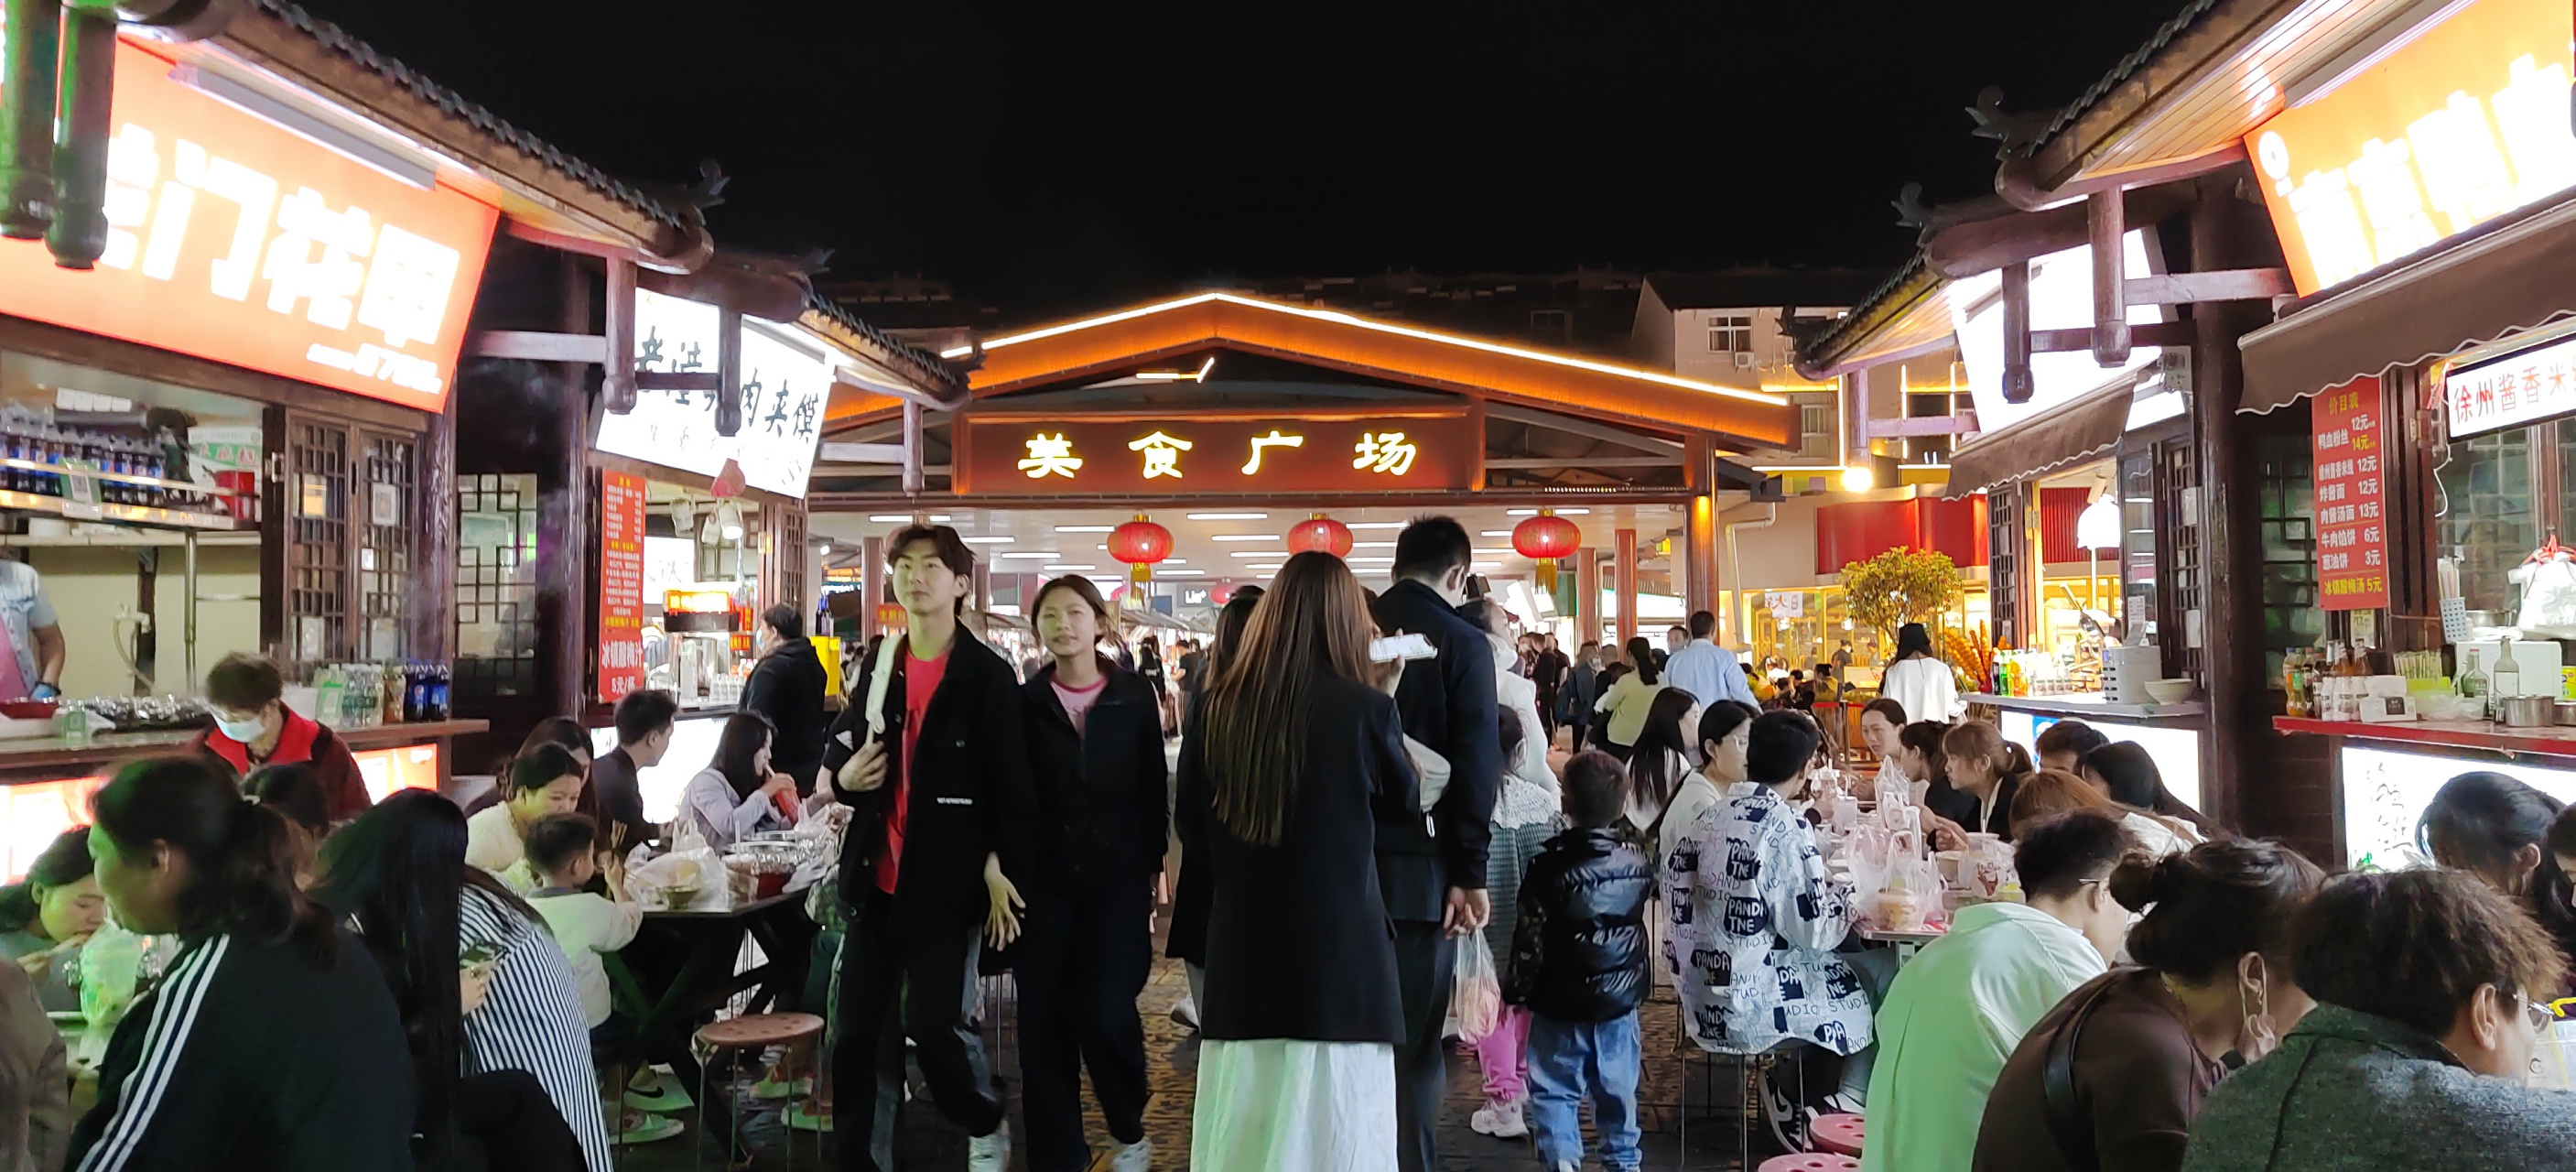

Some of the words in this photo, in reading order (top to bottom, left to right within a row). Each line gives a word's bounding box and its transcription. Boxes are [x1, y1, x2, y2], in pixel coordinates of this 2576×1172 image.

[2454, 355, 2576, 424] 徐州酱香米
[2329, 392, 2359, 415] 价目表
[1017, 430, 1417, 479] 美食广场
[2357, 455, 2377, 472] 12元
[2358, 478, 2377, 494] 12元
[2359, 501, 2379, 518] 13元
[2364, 526, 2379, 543] 6元
[2322, 551, 2348, 570] 葱油饼
[2365, 549, 2381, 566] 3元
[2366, 577, 2382, 592] 5元
[1729, 917, 1755, 934] TNE
[1696, 952, 1729, 971] PANDA
